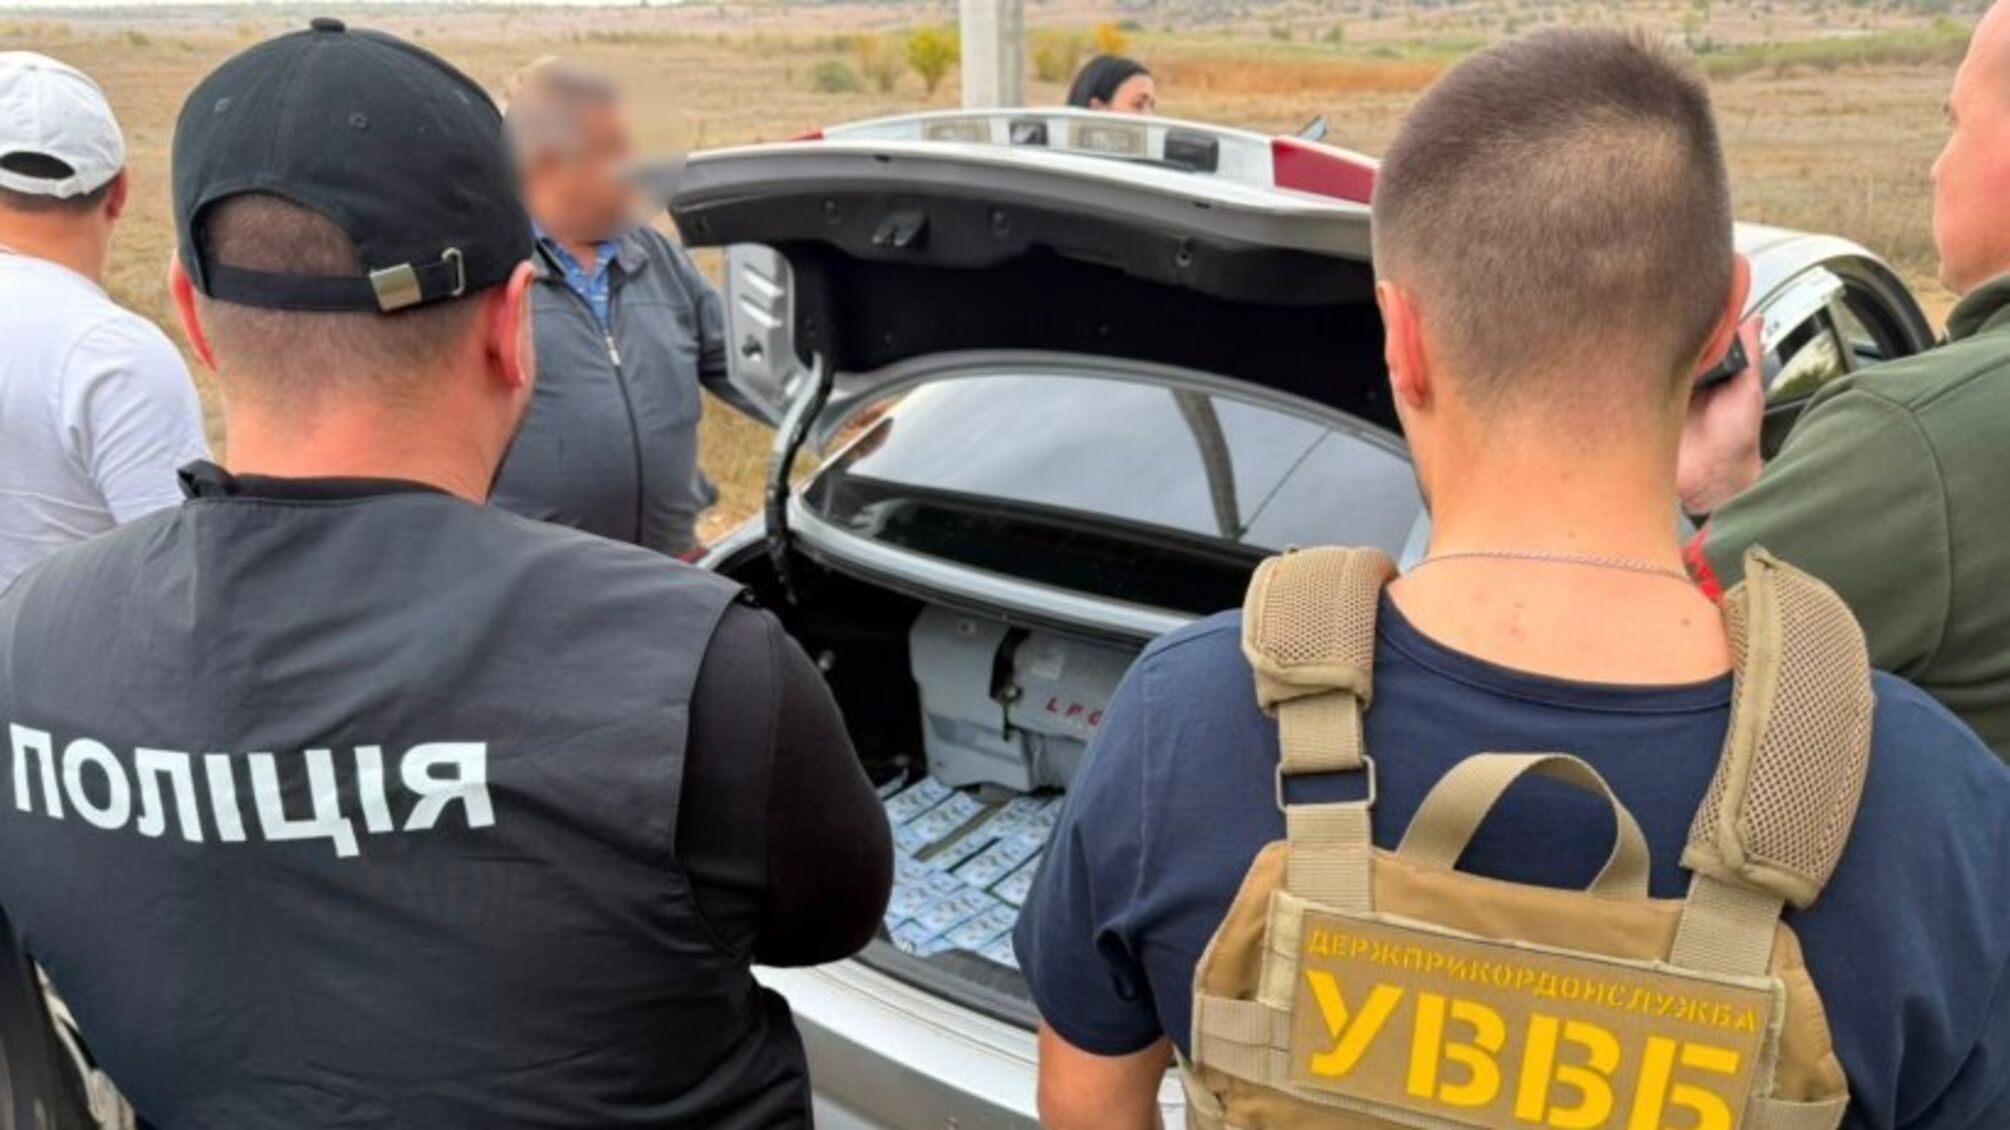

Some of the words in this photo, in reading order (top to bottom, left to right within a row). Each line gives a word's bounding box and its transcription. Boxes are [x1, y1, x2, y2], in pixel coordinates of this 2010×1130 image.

[9, 722, 496, 858] ПОЛІЦІЯ
[1307, 928, 1758, 1034] ДЕРЖПРИКОРДОНСЛУЖБА
[1305, 969, 1742, 1130] УВВБ
